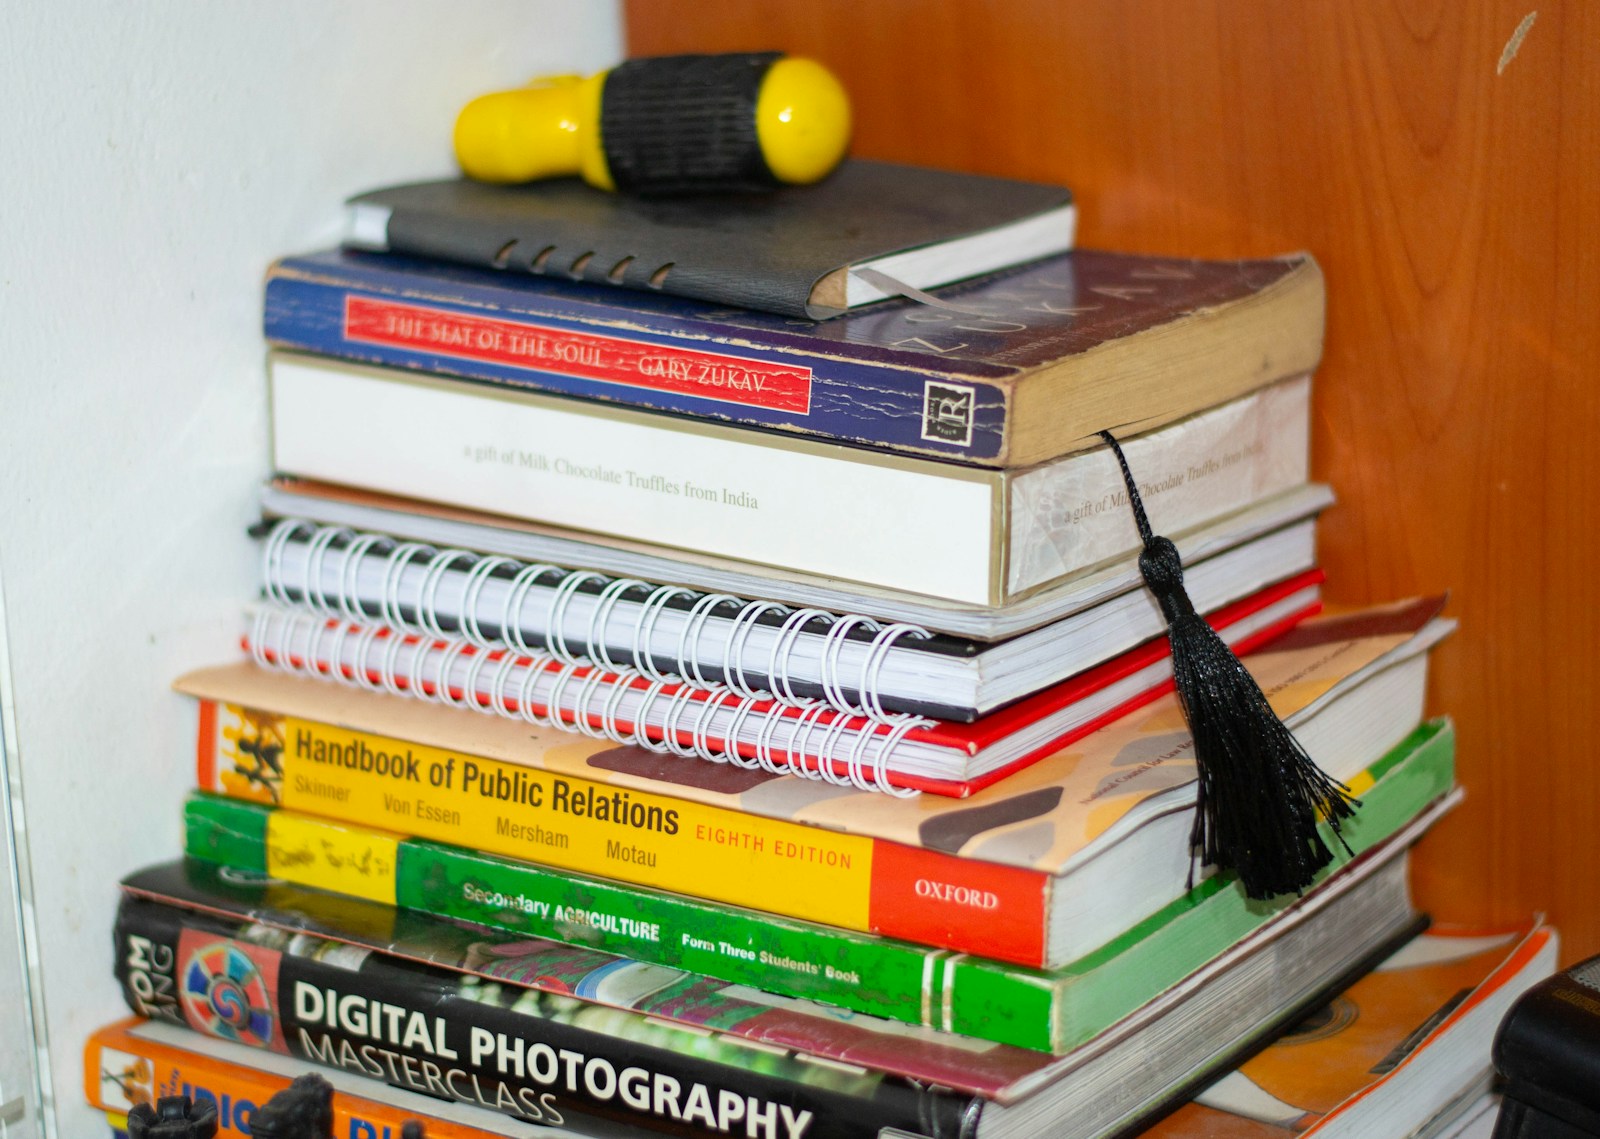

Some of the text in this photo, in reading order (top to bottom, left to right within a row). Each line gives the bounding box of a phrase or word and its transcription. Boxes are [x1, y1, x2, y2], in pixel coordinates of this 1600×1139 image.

[387, 316, 767, 393] THE SEAT OF THE SOUL GARY ZUKAV
[939, 394, 968, 427] R
[464, 446, 759, 510] a gift of Milk Chocolate Truffles from India
[1064, 510, 1071, 523] a
[1072, 502, 1093, 524] gift
[1094, 496, 1108, 514] of
[1109, 488, 1132, 510] Mil
[1138, 472, 1186, 499] Chocolate
[1186, 460, 1221, 482] Truffles
[294, 774, 658, 869] Skinner Von Essen Mersham Motau
[296, 728, 852, 870] Handbook of Public Relations EIGHTH EDITION
[463, 882, 661, 943] Secondary AGRICULTURE
[914, 878, 999, 909] OXFORD
[126, 933, 162, 1018] TOM
[682, 933, 861, 985] Form Three Students' Book
[294, 980, 814, 1139] DIGITAL PHOTOGRAPHY
[299, 1027, 567, 1127] MASTERCLASS
